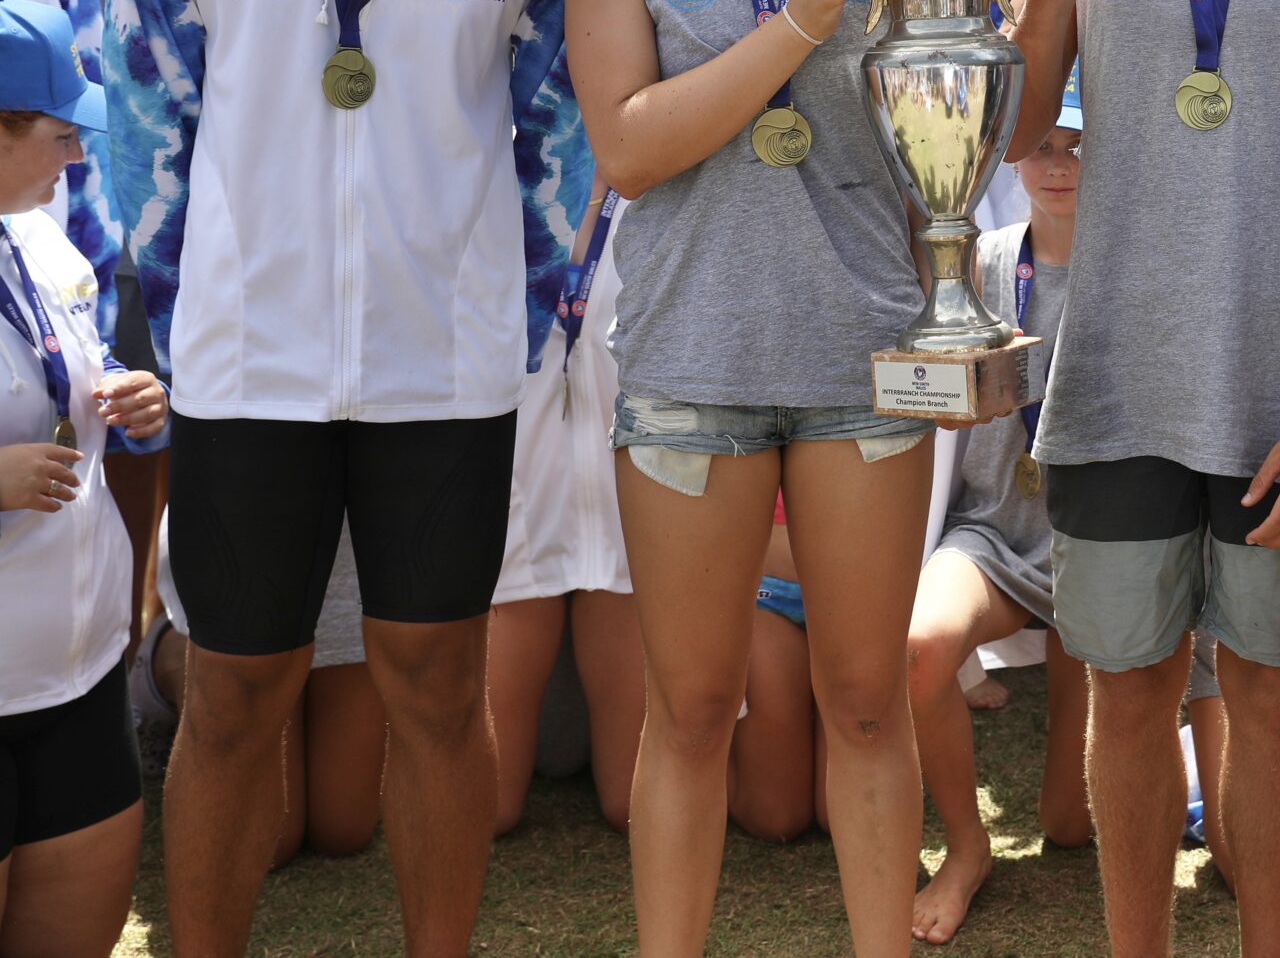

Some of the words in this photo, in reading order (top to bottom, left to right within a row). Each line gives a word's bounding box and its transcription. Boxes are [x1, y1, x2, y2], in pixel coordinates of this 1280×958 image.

[882, 388, 919, 397] INTERBRANCH
[919, 390, 961, 399] CHAMPIONSHIP
[895, 398, 926, 407] Champion
[927, 400, 949, 408] Branch
